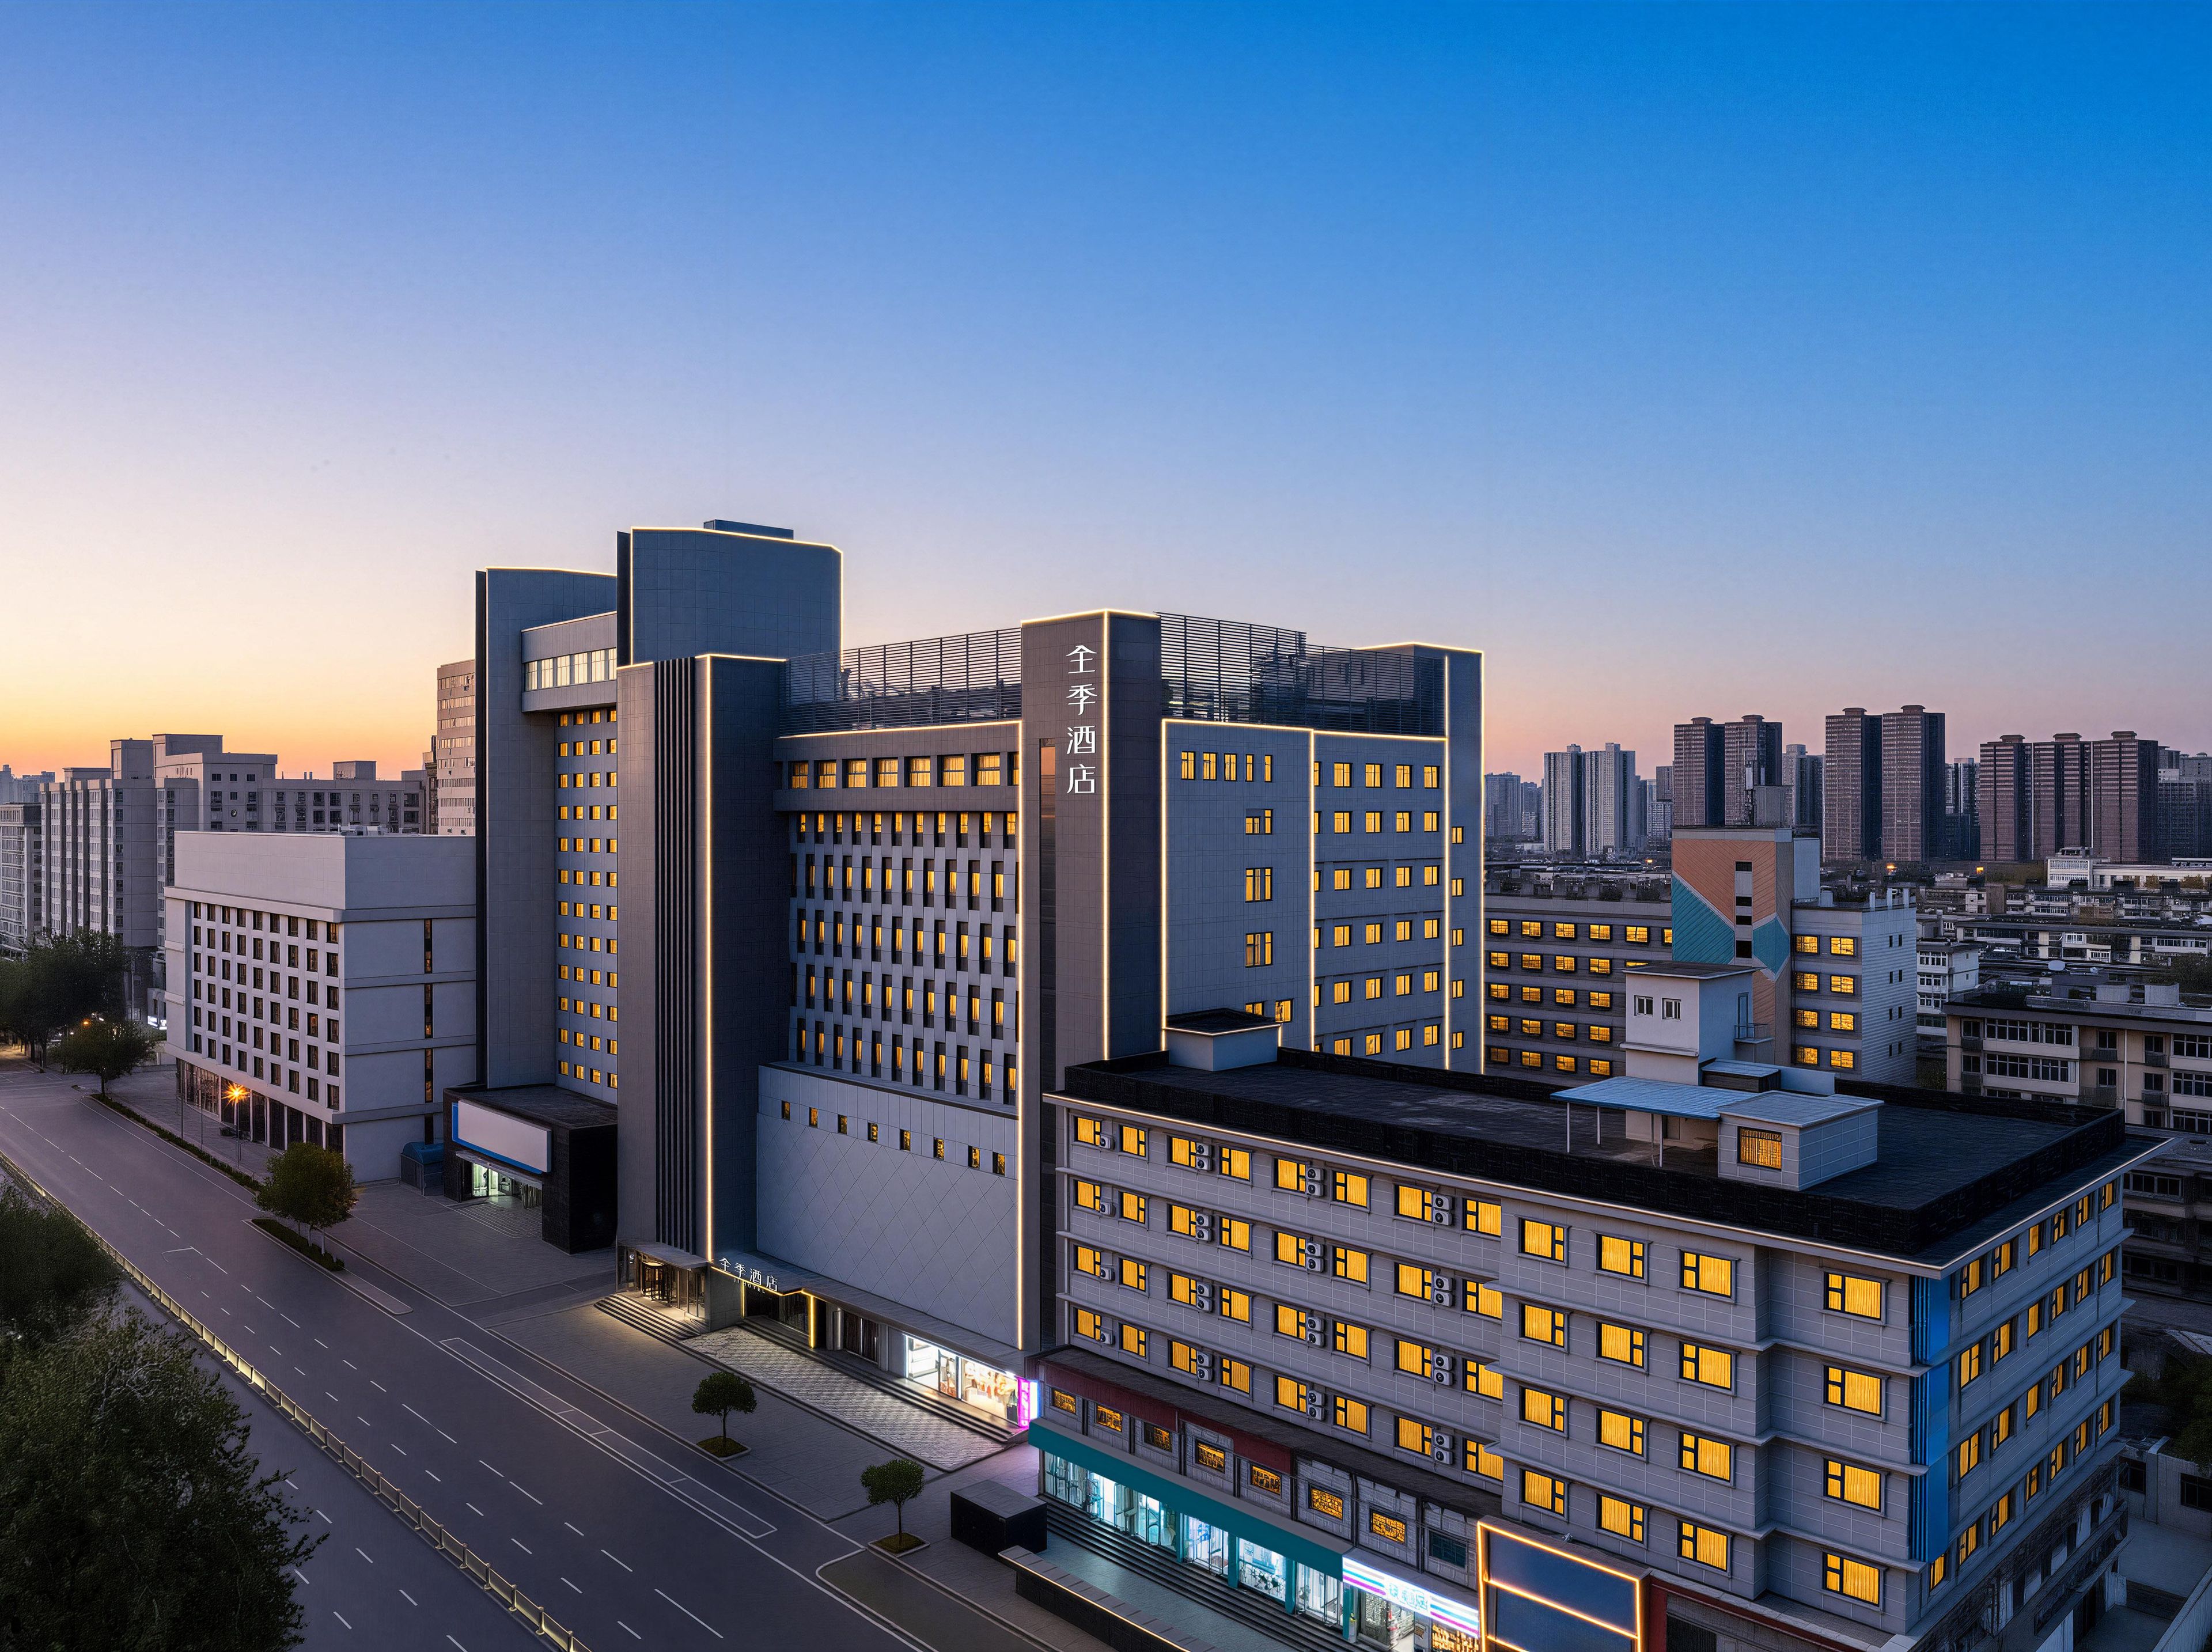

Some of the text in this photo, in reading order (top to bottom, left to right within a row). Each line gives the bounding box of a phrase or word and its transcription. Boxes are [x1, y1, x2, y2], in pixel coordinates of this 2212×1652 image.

[1066, 645, 1097, 794] 全季酒店
[719, 1257, 778, 1291] 全季酒店
[743, 1282, 766, 1294] HOTEL
